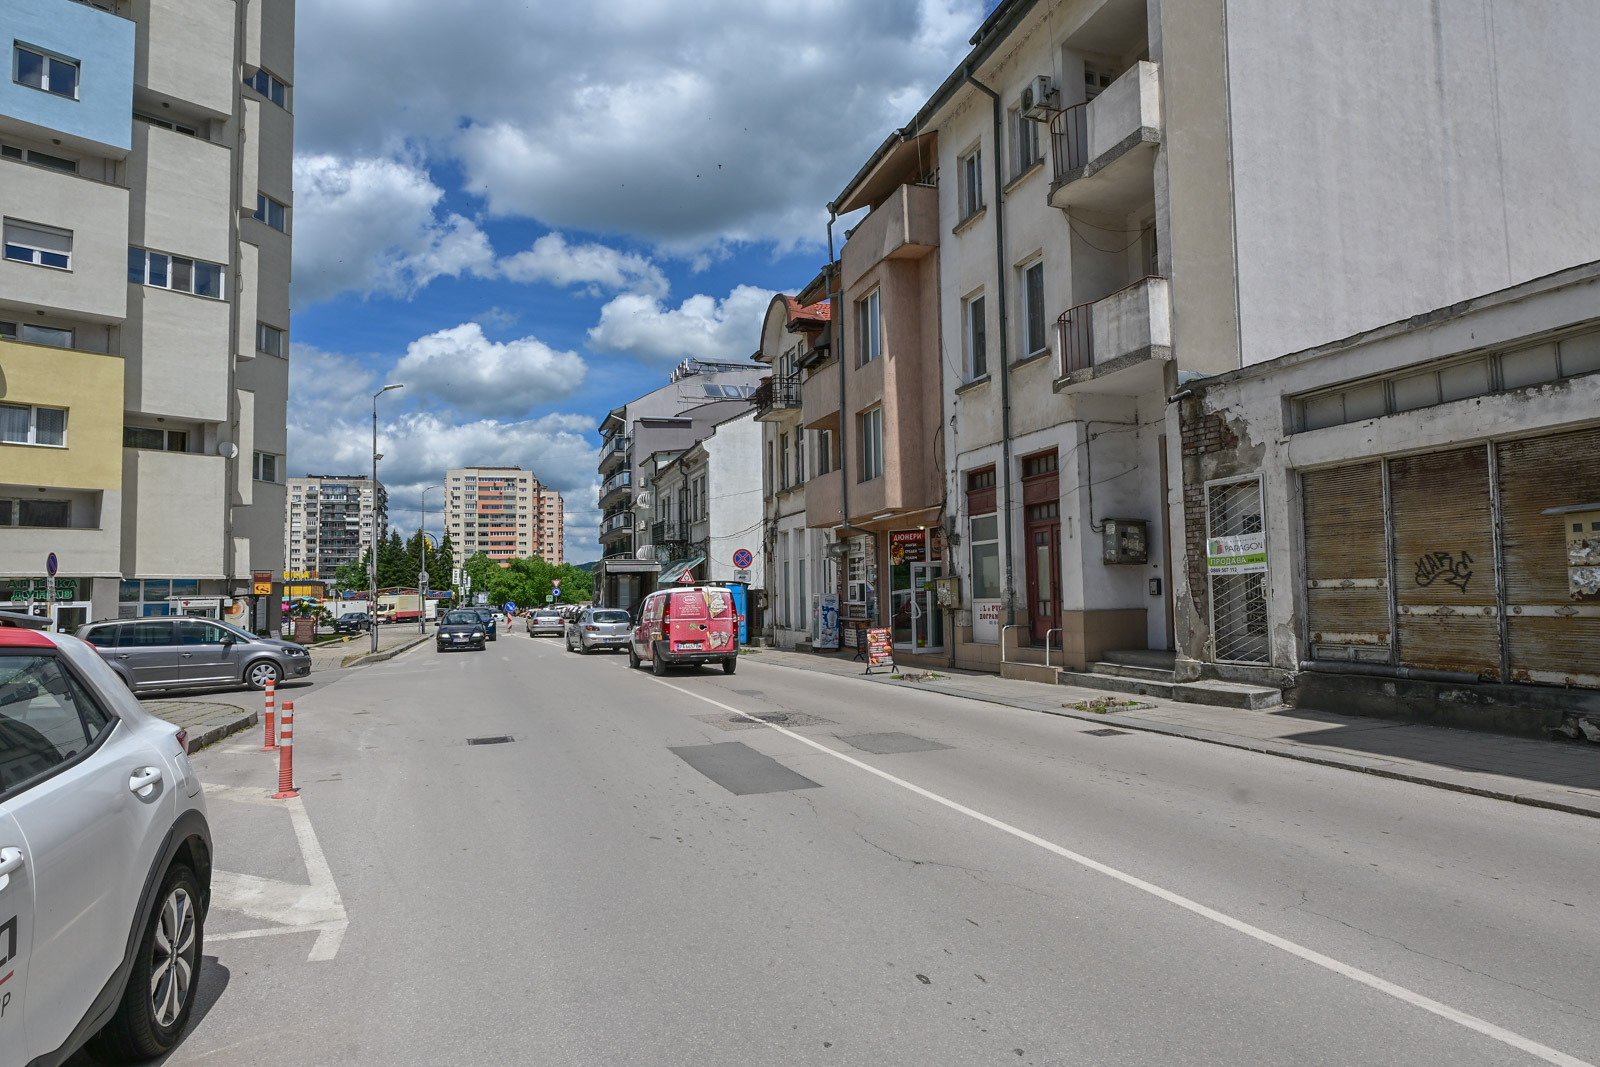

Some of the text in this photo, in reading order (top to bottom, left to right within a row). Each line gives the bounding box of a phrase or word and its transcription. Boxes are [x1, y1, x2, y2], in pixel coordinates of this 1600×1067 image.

[893, 533, 922, 541] ДЮНЕРИ
[1224, 541, 1263, 552] PARAGON
[1210, 557, 1247, 565] ПРОДАВА
[283, 571, 310, 579] BILLA
[7, 579, 78, 588] АПТКА
